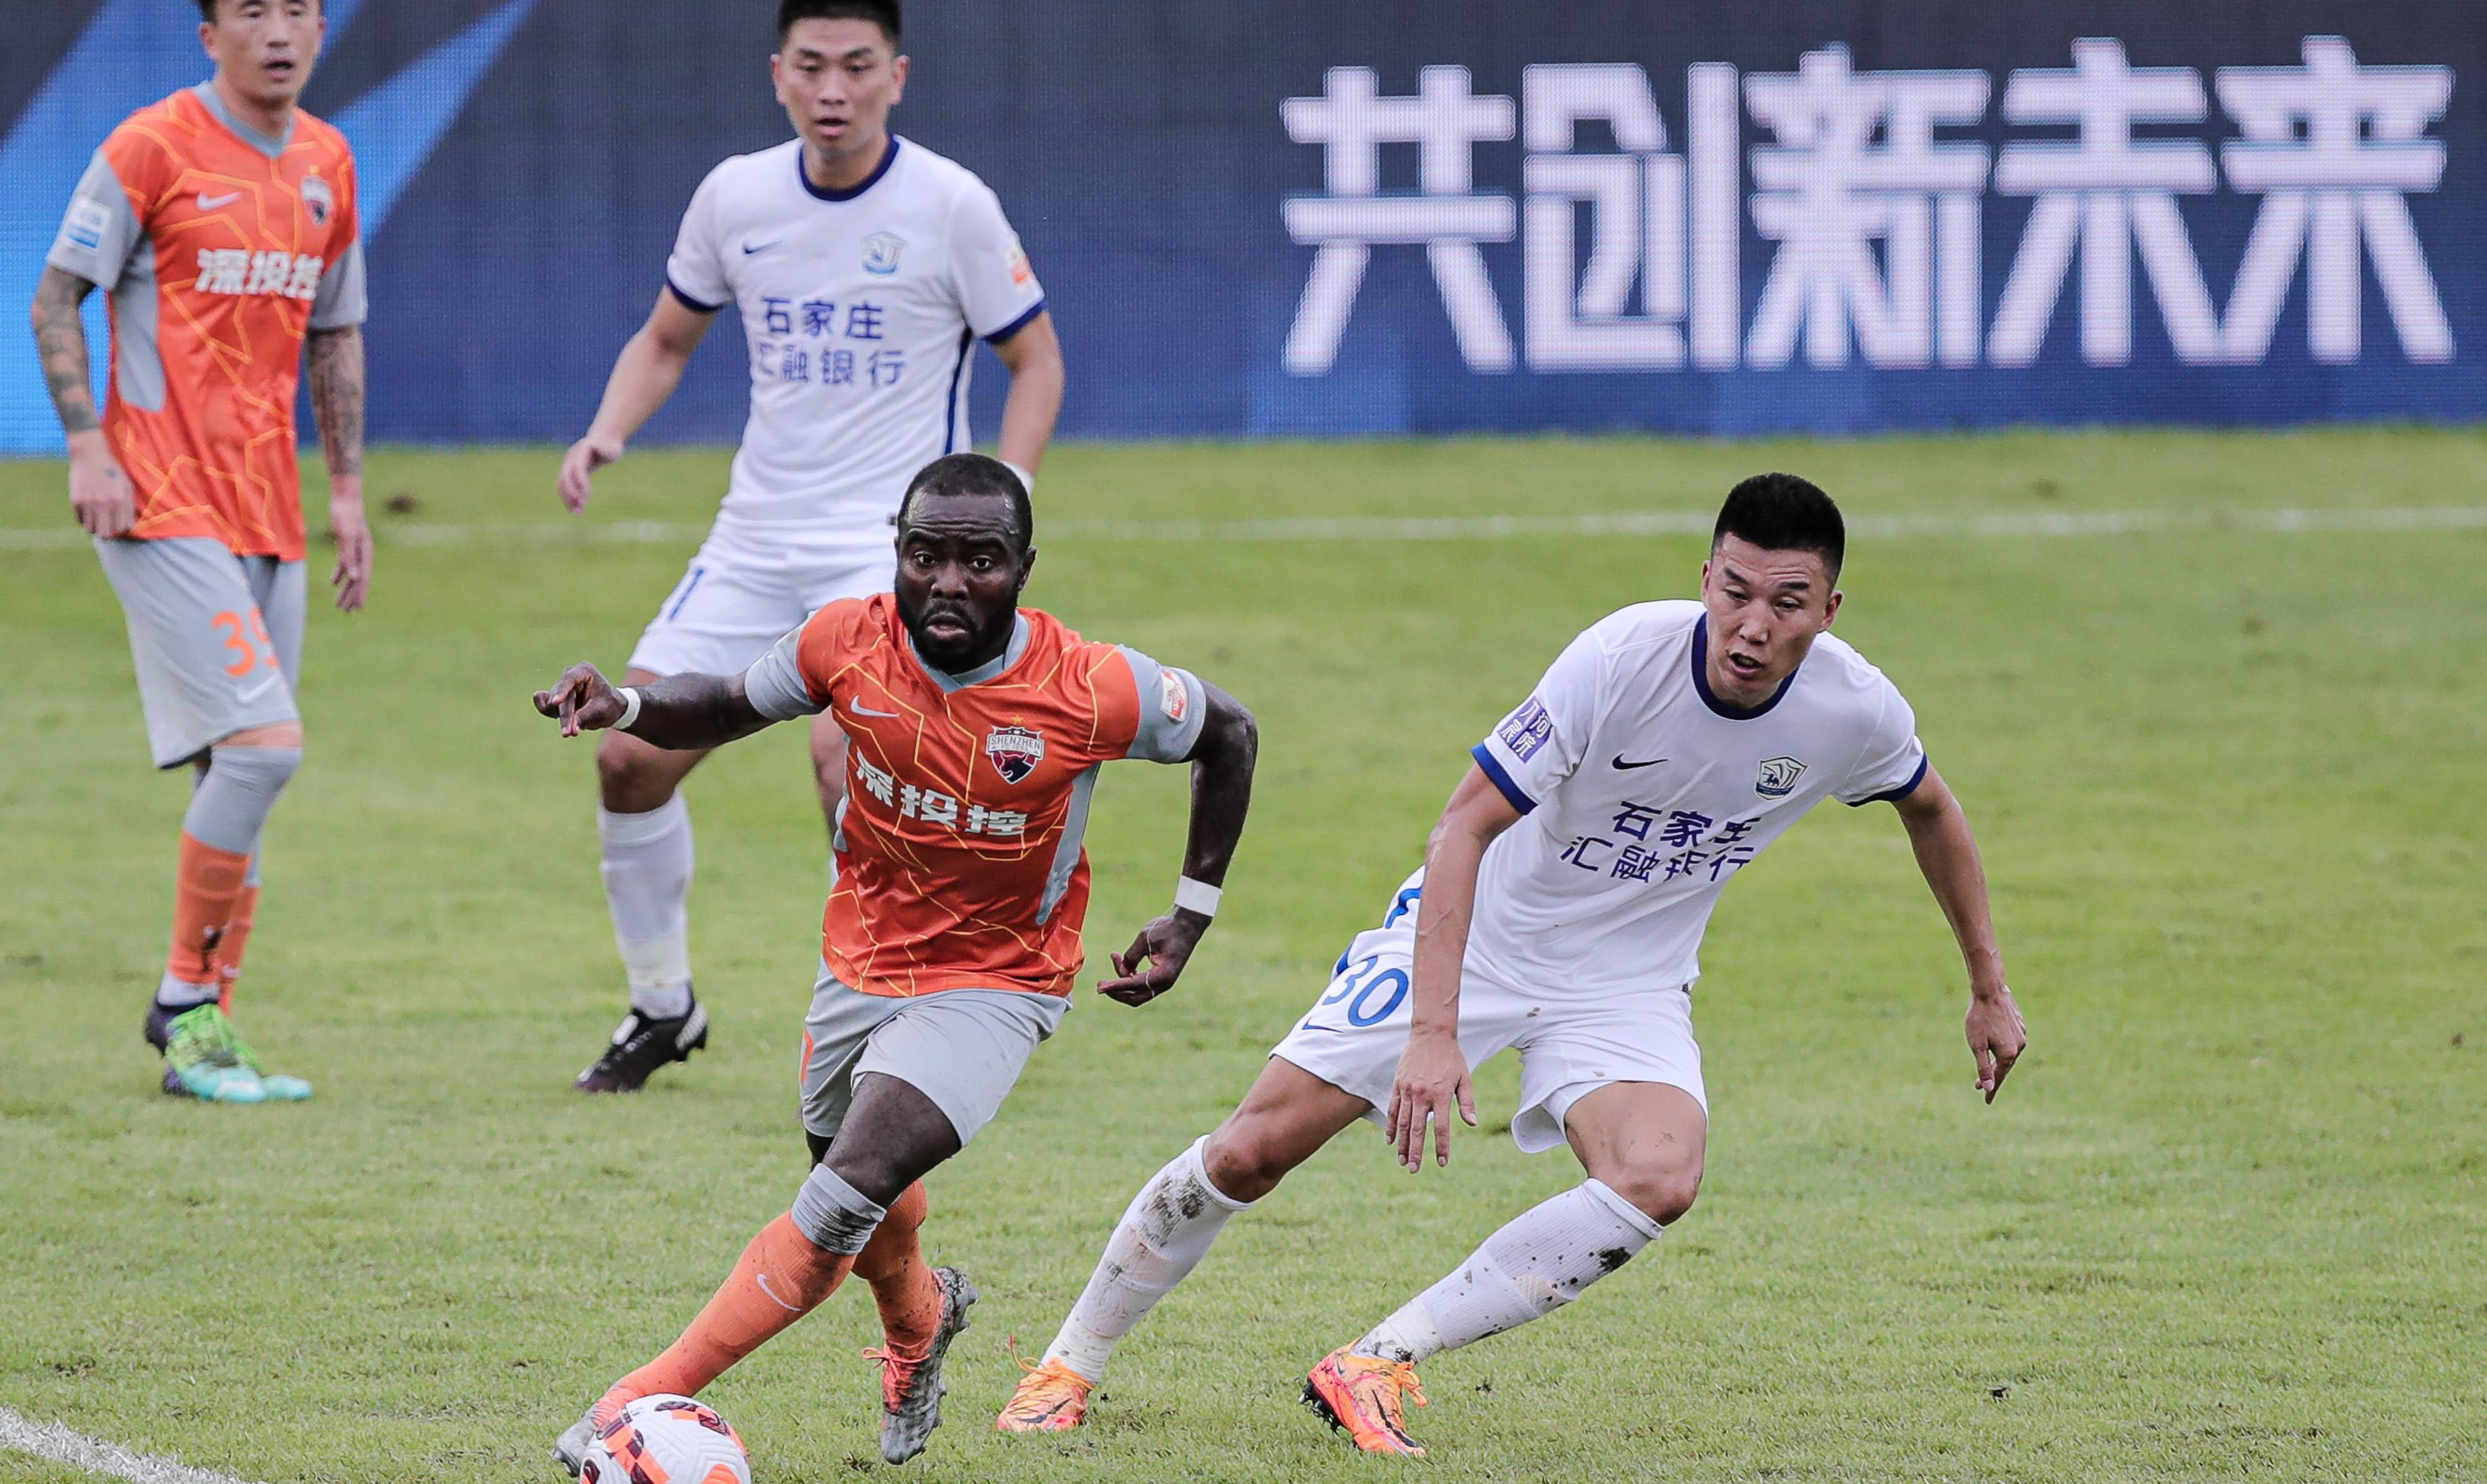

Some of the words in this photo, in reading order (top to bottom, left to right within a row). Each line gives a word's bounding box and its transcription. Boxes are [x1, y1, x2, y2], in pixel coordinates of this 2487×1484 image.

[1281, 35, 2455, 374] 共创新未来
[195, 248, 324, 301] 深投控
[761, 298, 883, 339] 石家庄
[990, 735, 1041, 750] SHENZHEN
[1612, 800, 1761, 847] 石家庄
[1321, 955, 1410, 1027] 30
